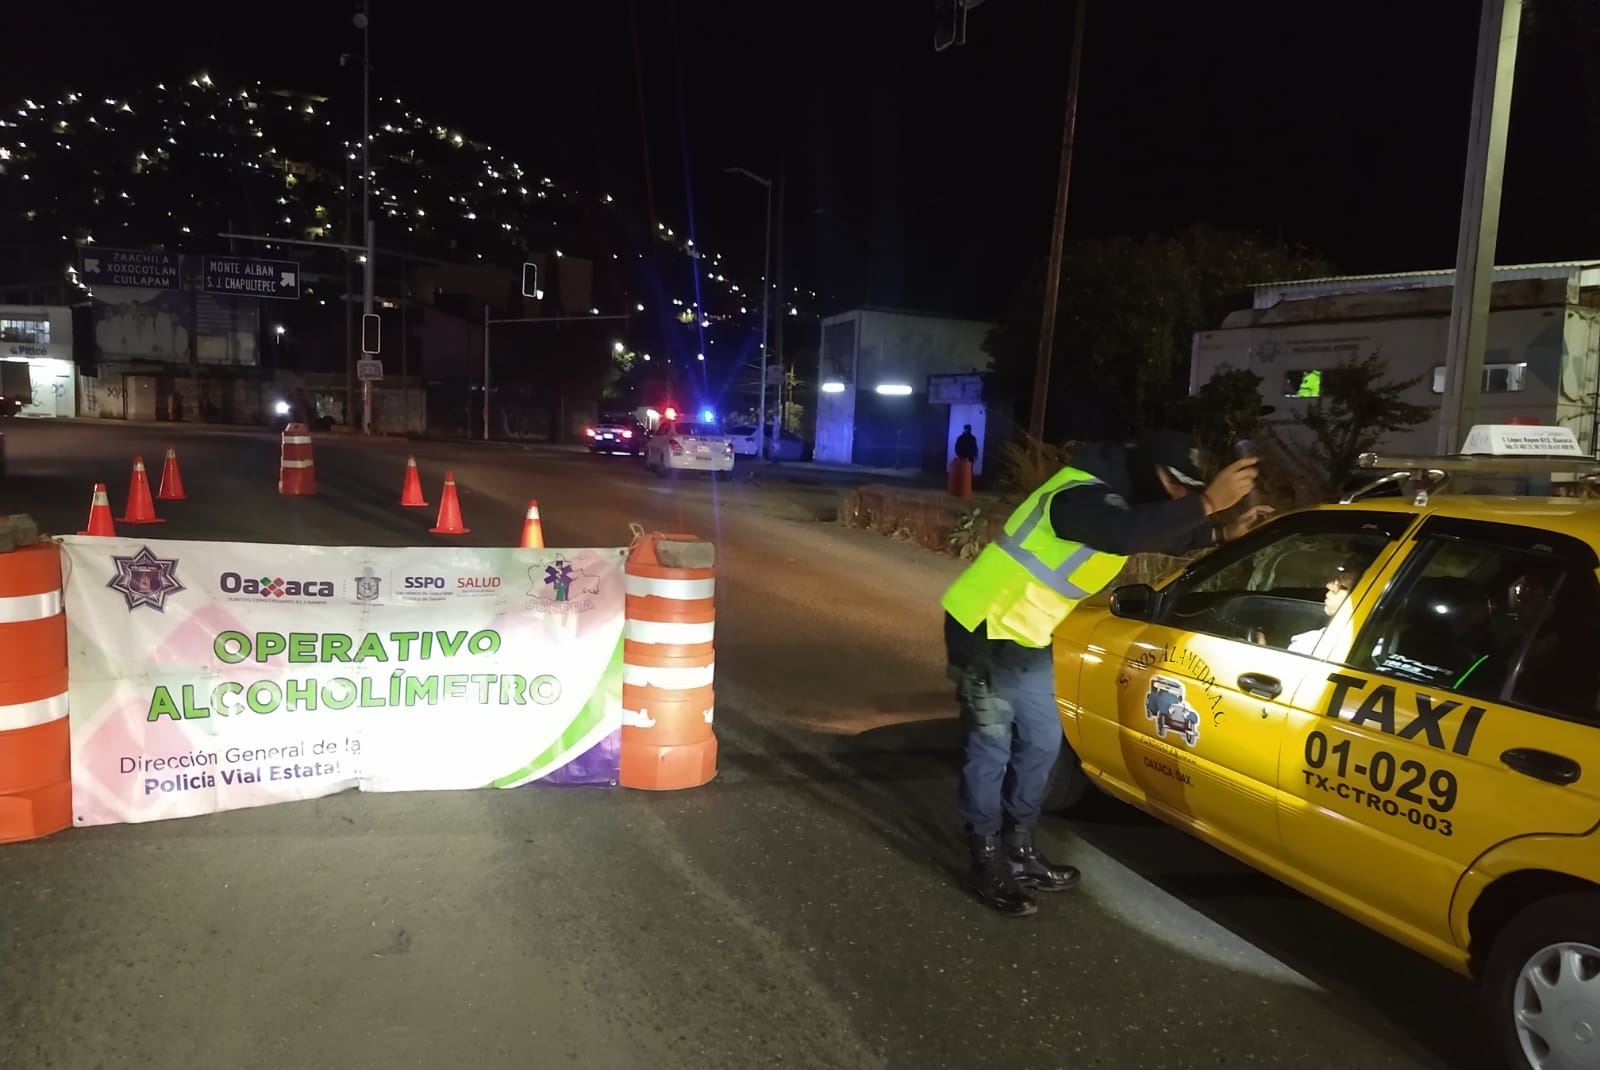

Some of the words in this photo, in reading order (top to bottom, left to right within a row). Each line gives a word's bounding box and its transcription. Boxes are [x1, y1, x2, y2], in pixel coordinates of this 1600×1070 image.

[106, 263, 176, 276] XOXOCOTLAN
[112, 252, 170, 265] ZAACHILA
[210, 261, 240, 274] MONTE
[113, 275, 170, 287] CUILAPAM
[207, 276, 216, 288] S.
[225, 279, 276, 293] CHAPULTEPEC
[220, 572, 335, 598] Oaxaca
[404, 576, 446, 589] SSPO
[457, 576, 501, 588] SALUD
[213, 629, 502, 664] OPERATIVO
[147, 668, 562, 722] ALCOHOLÍMETRO
[1325, 672, 1487, 757] TAXI
[120, 751, 218, 774] Dirección
[225, 741, 304, 764] General
[312, 739, 337, 755] de
[144, 770, 215, 795] Policía
[221, 767, 261, 786] Vial
[1304, 730, 1458, 813] 01-029
[1302, 769, 1454, 837] TX-CTRO-003
